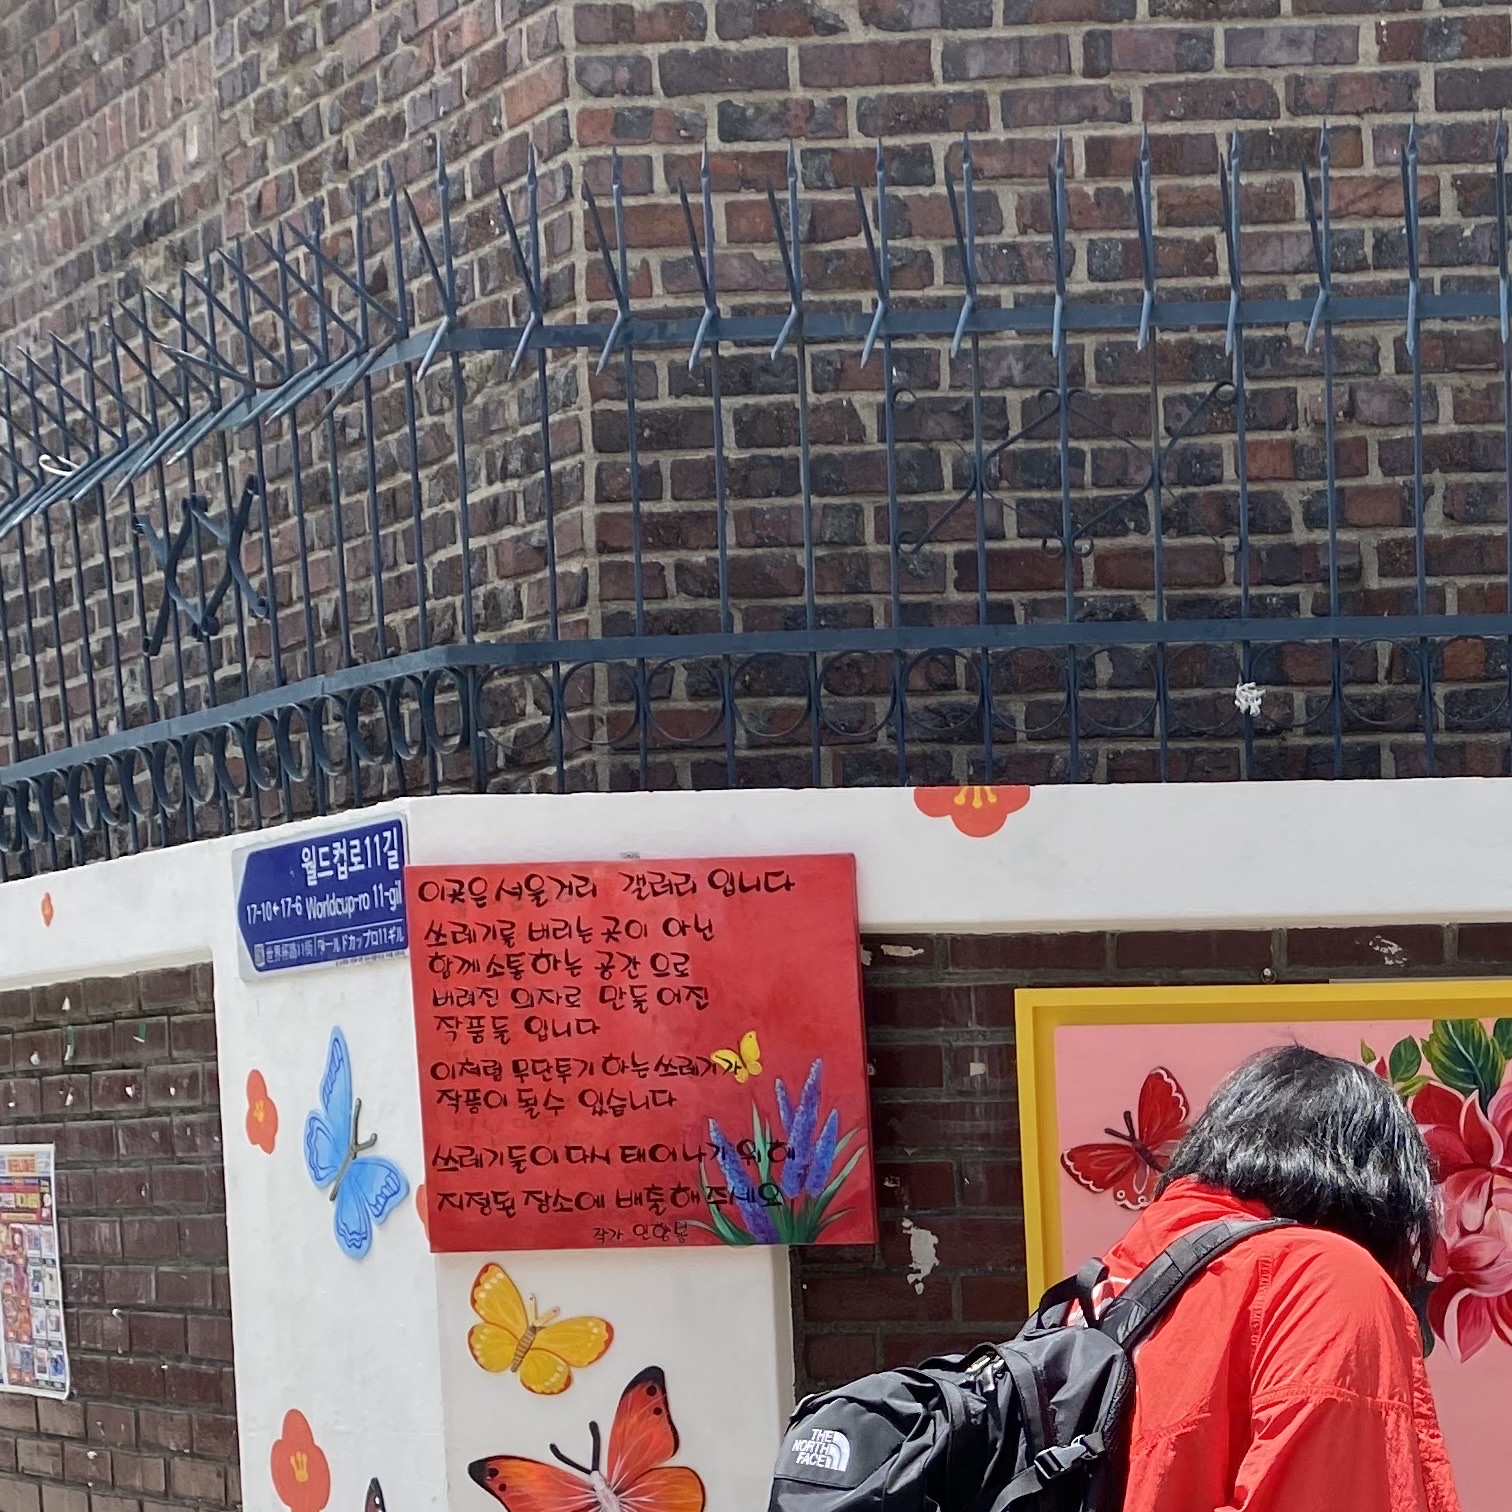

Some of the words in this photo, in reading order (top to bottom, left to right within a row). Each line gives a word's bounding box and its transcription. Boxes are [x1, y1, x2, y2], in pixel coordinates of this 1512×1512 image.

[301, 827, 399, 886] 월드컵로11길
[305, 892, 370, 920] Worldcup-ro
[372, 880, 403, 911] 11-gil
[418, 876, 488, 908] 이곳은
[618, 870, 697, 900] 갤러리
[707, 868, 796, 897] 입니다
[424, 919, 516, 948] 쓰레기를
[528, 915, 593, 944] 버리는
[601, 915, 648, 943] 곳이
[662, 913, 715, 941] 아닌
[432, 986, 499, 1008] 버려진
[510, 985, 582, 1009] 의자로
[433, 1015, 511, 1045] 작품들
[524, 1015, 601, 1042] 입니다
[430, 1057, 503, 1082] 이처럼
[436, 1088, 508, 1115] 작품이
[577, 1087, 678, 1117] 있습니다
[432, 1144, 559, 1174] 쓰레기들이
[564, 1145, 611, 1165] 다시
[618, 1142, 726, 1164] 태어나기
[736, 1138, 796, 1167] 위해
[436, 1190, 517, 1219] 지정된
[521, 1188, 605, 1214] 장소에
[592, 1227, 624, 1244] 작가
[791, 1438, 831, 1456] NORTH
[811, 1428, 834, 1443] THE
[795, 1451, 827, 1468] FACE
